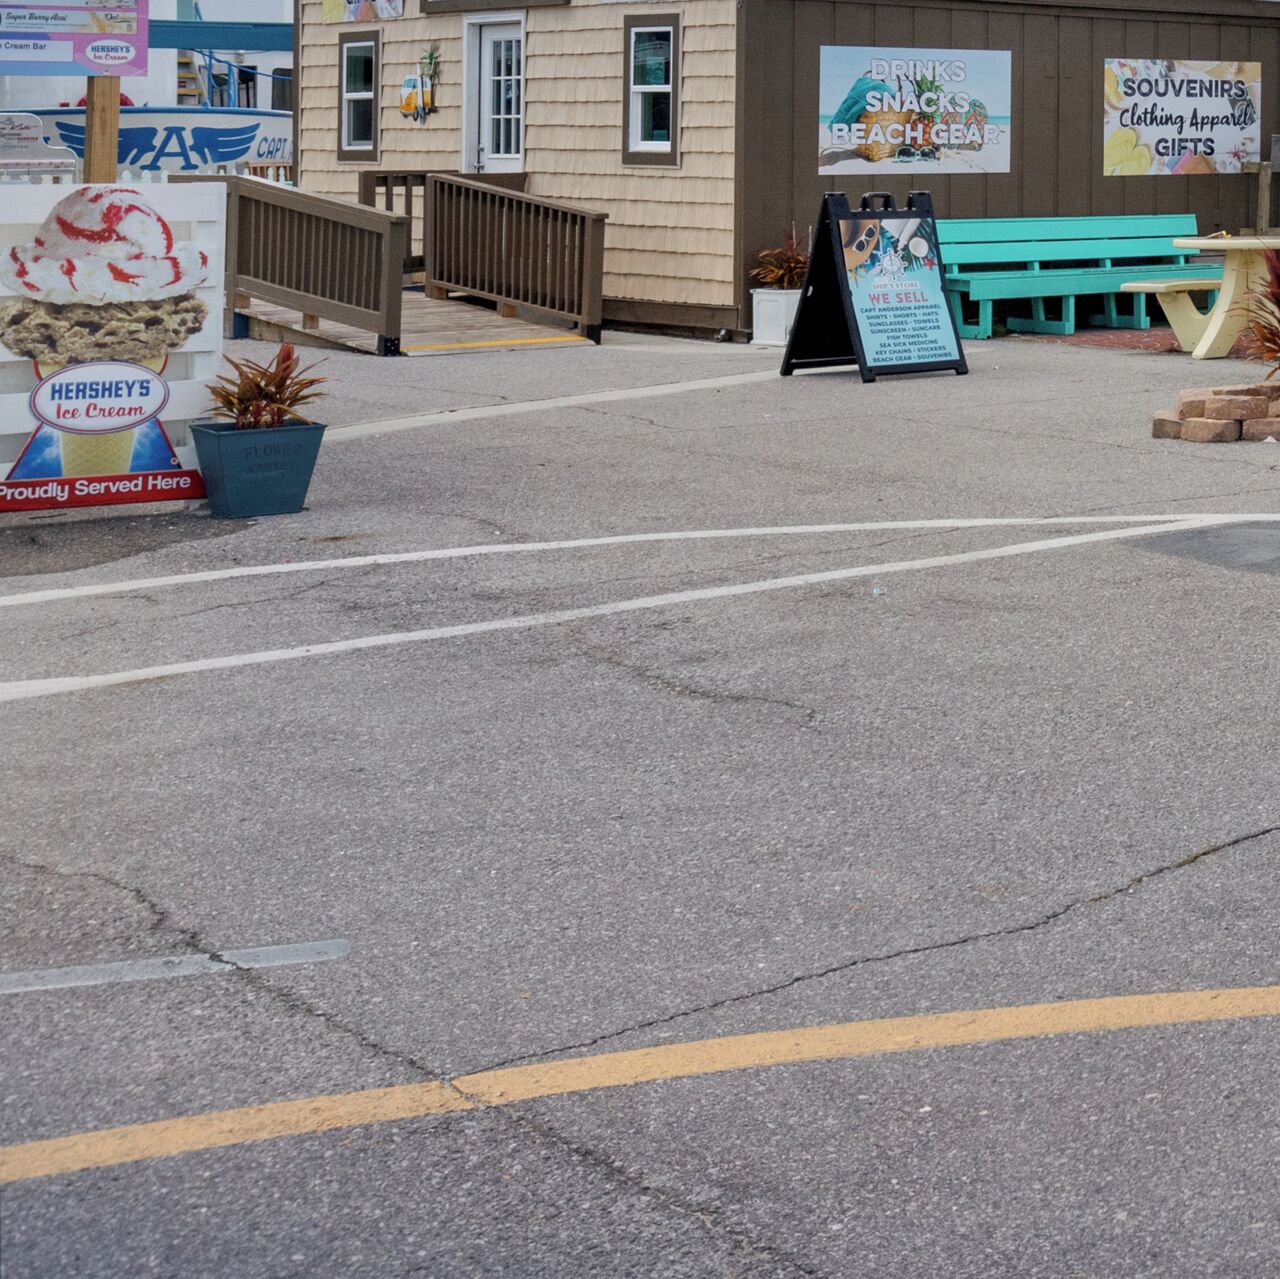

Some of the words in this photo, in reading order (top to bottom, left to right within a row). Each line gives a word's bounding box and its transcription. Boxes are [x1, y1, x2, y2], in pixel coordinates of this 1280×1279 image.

[6, 12, 26, 22] Super
[5, 42, 31, 50] Cream
[91, 45, 131, 53] HERSHEY'S
[871, 59, 966, 82] DRINKS
[1123, 78, 1246, 98] SOUVENIRS
[865, 91, 970, 113] SNACKS
[1119, 102, 1185, 135] Clothing
[1189, 105, 1250, 132] Apparel
[831, 123, 924, 145] BEACH
[930, 123, 1000, 145] GEAR
[1155, 138, 1215, 157] GIFTS
[869, 293, 890, 304] WE
[895, 291, 928, 304] SELL
[917, 352, 953, 360] SOUVENIRS
[51, 379, 151, 401] HERSHEY'S
[56, 403, 82, 419] Ice
[85, 403, 146, 418] Cream
[0, 482, 69, 501] Proudly
[74, 476, 143, 496] Served
[148, 474, 192, 490] Here
